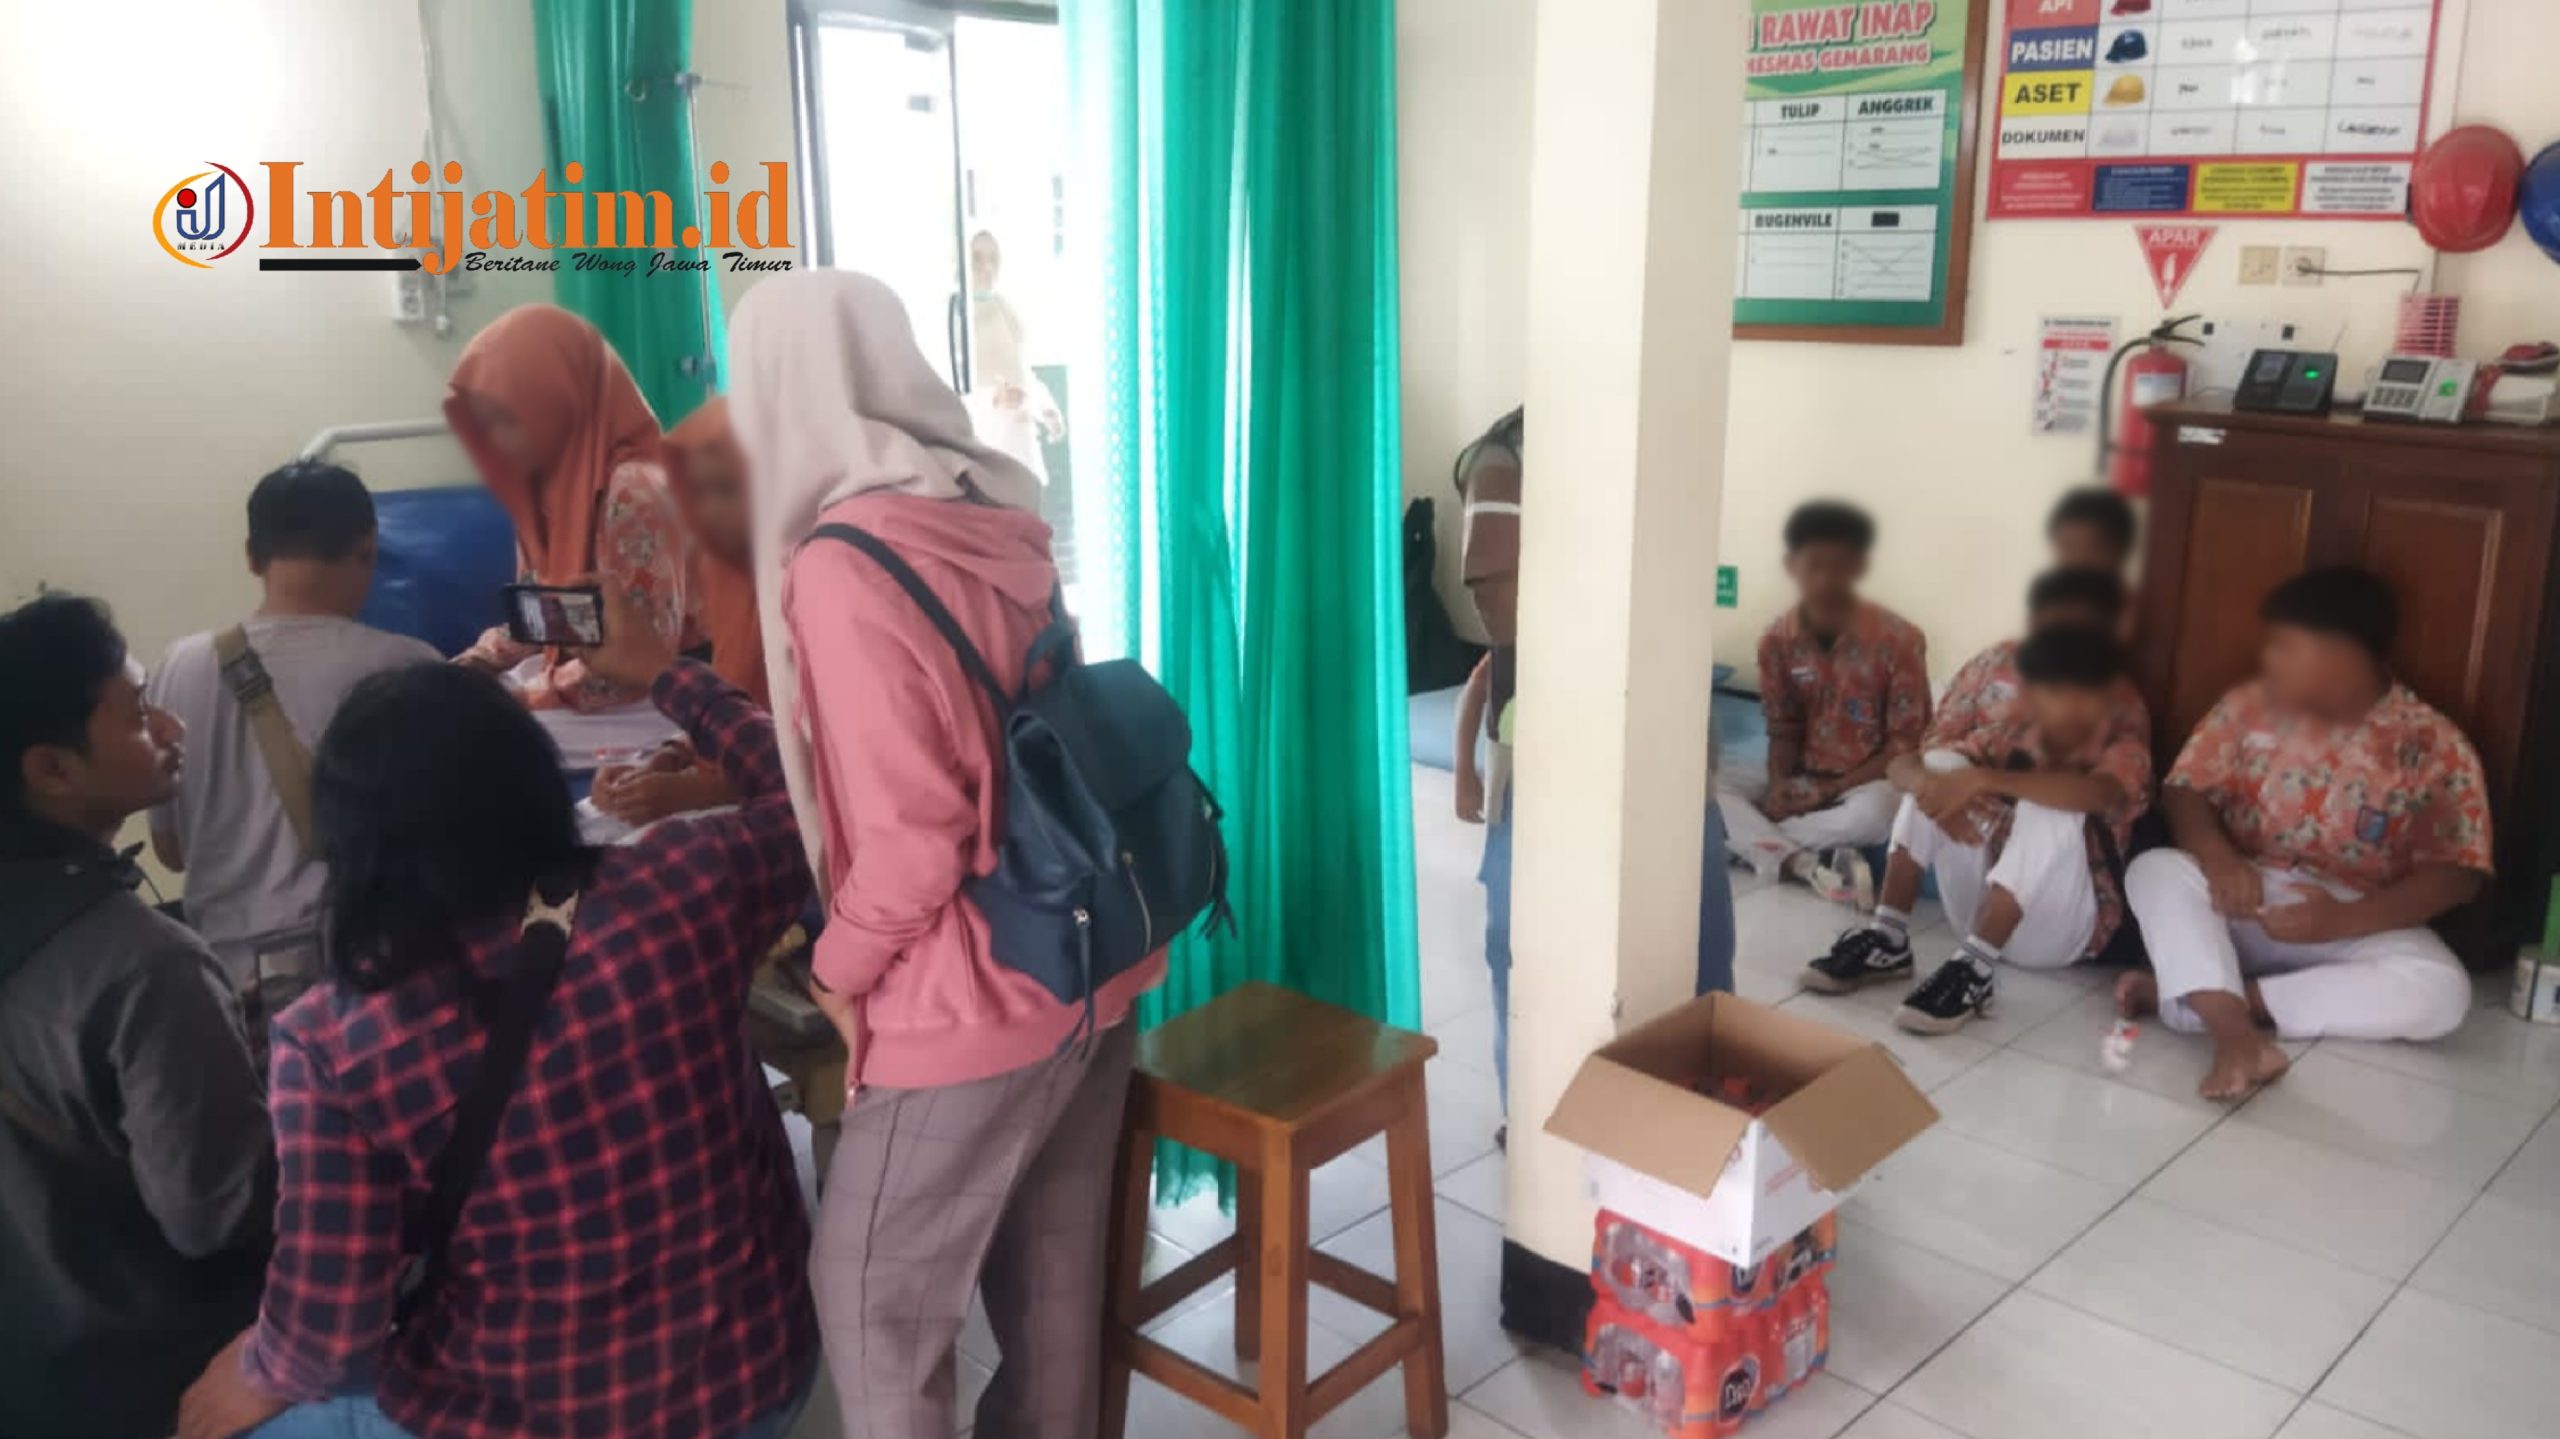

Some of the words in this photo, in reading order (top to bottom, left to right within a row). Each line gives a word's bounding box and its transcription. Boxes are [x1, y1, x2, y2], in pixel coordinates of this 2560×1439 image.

[1761, 5, 1855, 46] RAWAT
[1861, 0, 1933, 39] INAP
[1819, 43, 1929, 70] GEMARANG
[2011, 37, 2094, 64] PASIEN
[2014, 82, 2082, 104] ASET
[1780, 103, 1820, 119] TULIP
[1858, 97, 1934, 116] ANGGREK
[2001, 128, 2086, 145] DOKUMEN
[1755, 213, 1833, 229] BUGENVILE
[2149, 227, 2200, 245] APAR
